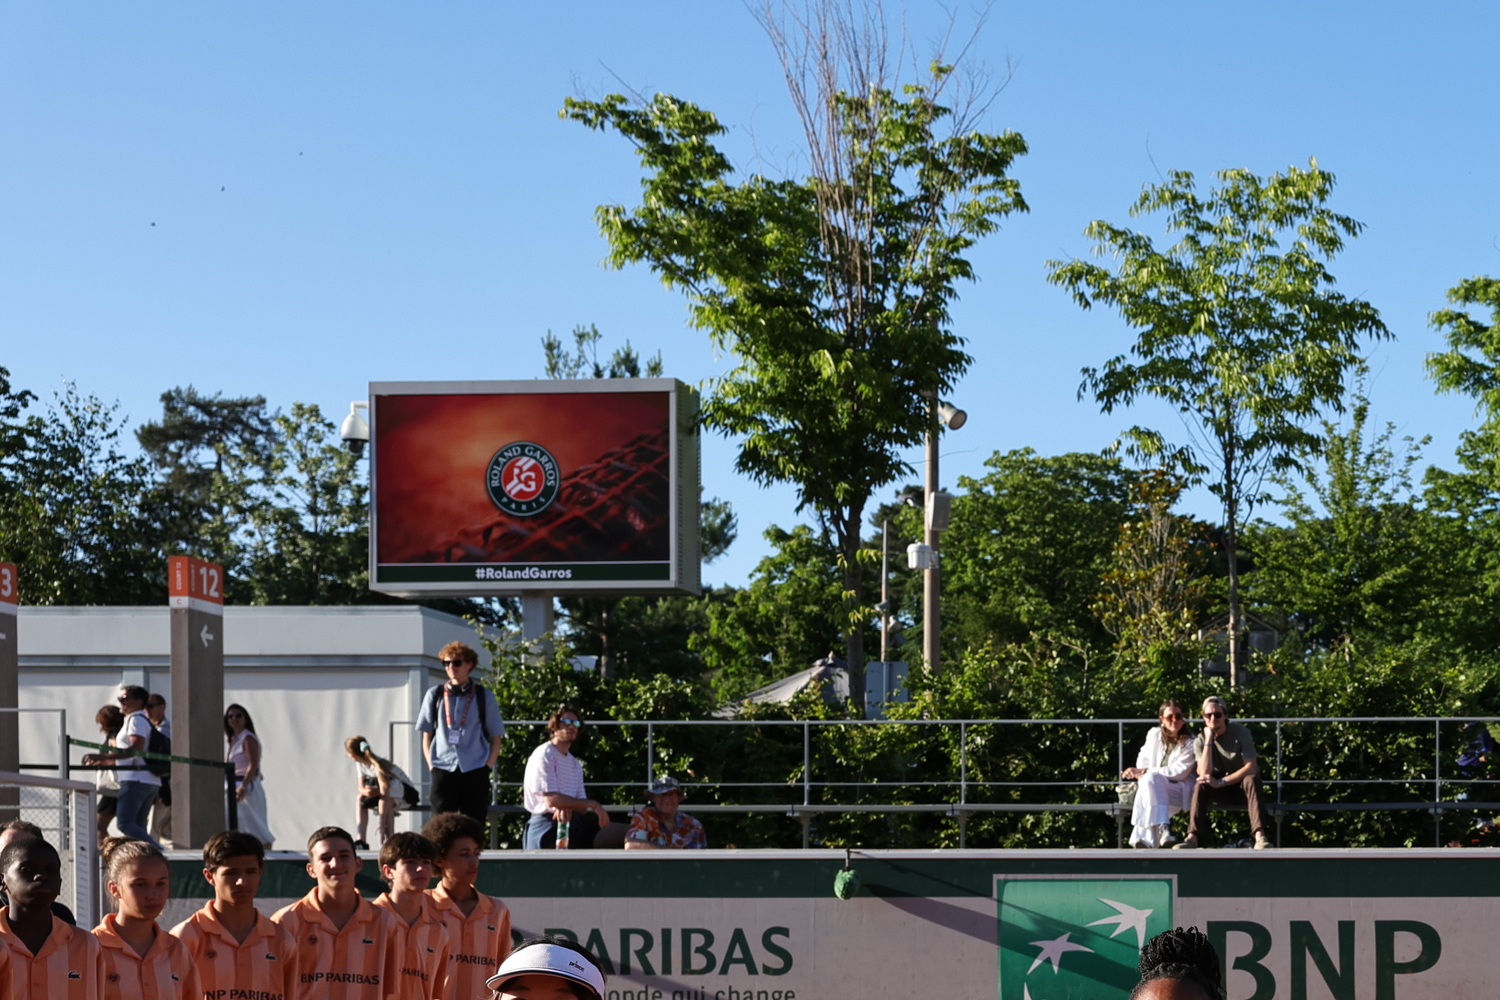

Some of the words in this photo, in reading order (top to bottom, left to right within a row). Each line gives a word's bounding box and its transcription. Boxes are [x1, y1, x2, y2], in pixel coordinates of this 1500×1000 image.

[491, 446, 521, 487] ROLAND
[524, 446, 556, 487] GARROS
[501, 496, 546, 511] PARIS
[475, 567, 572, 579] #RolandGarros
[199, 566, 220, 598] 12
[300, 973, 325, 983] BNP
[326, 973, 380, 985] PARIBAS
[206, 990, 226, 1000] NP
